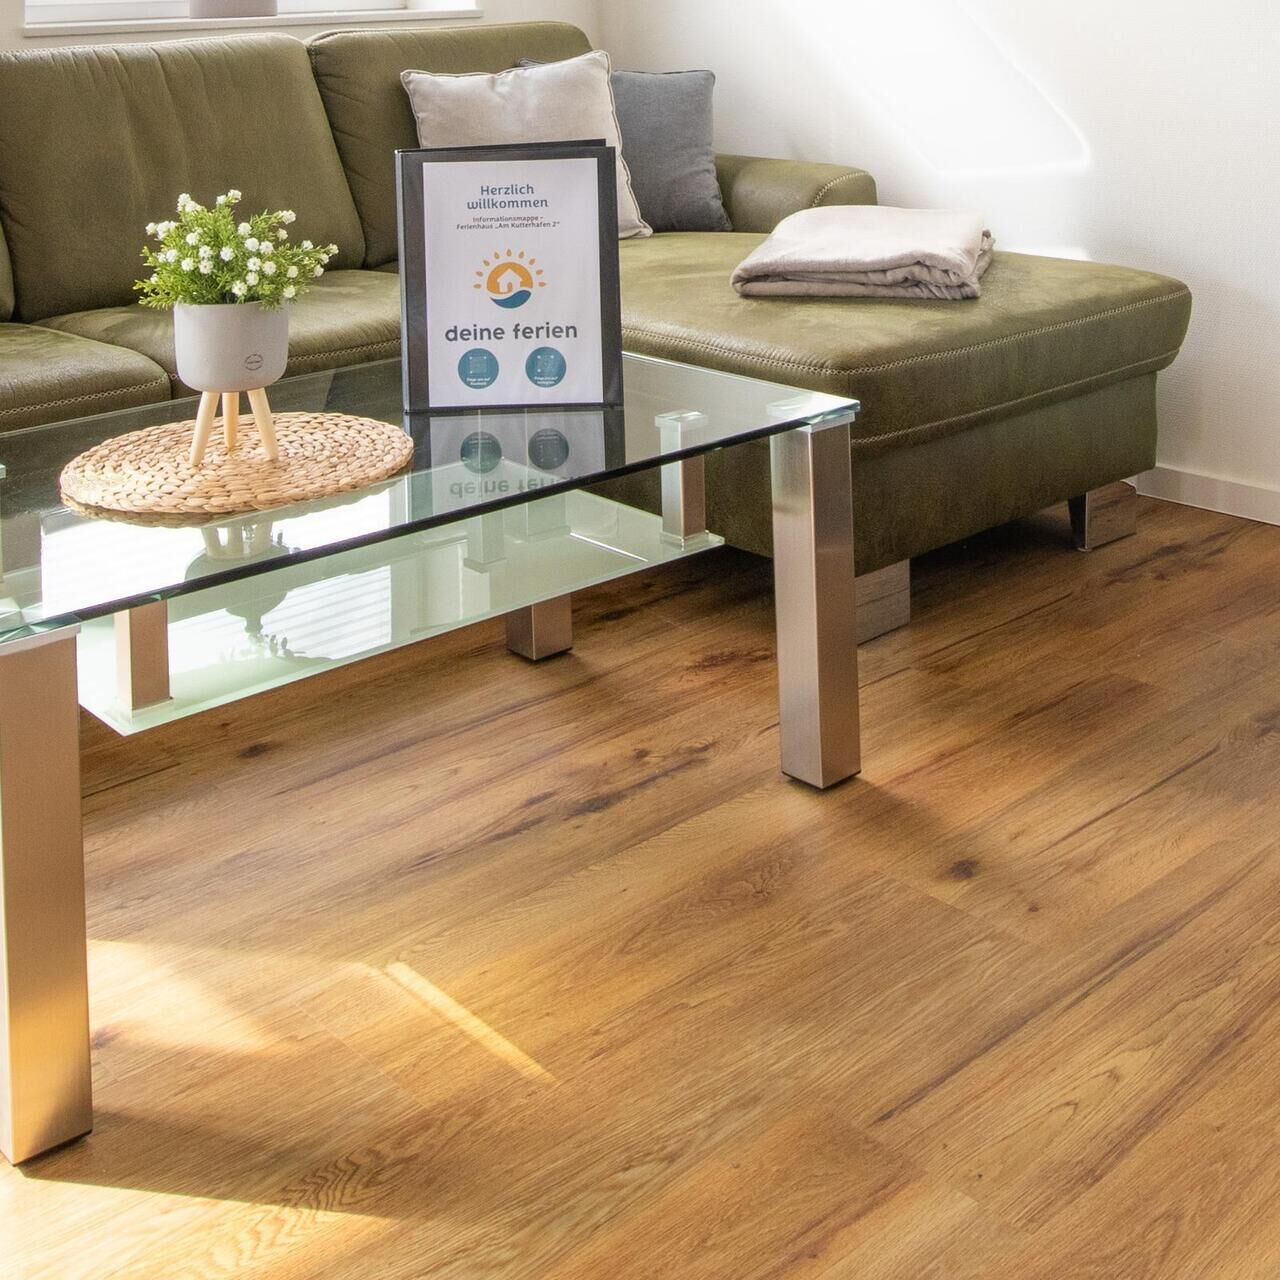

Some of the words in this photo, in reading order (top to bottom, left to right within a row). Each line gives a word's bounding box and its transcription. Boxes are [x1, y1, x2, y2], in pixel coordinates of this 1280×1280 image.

[480, 184, 535, 196] Herzlich
[466, 198, 548, 210] willkommen
[472, 215, 539, 223] Informationsmappe
[456, 222, 493, 230] Ferienhaus
[445, 324, 505, 341] deine
[513, 322, 578, 339] ferien
